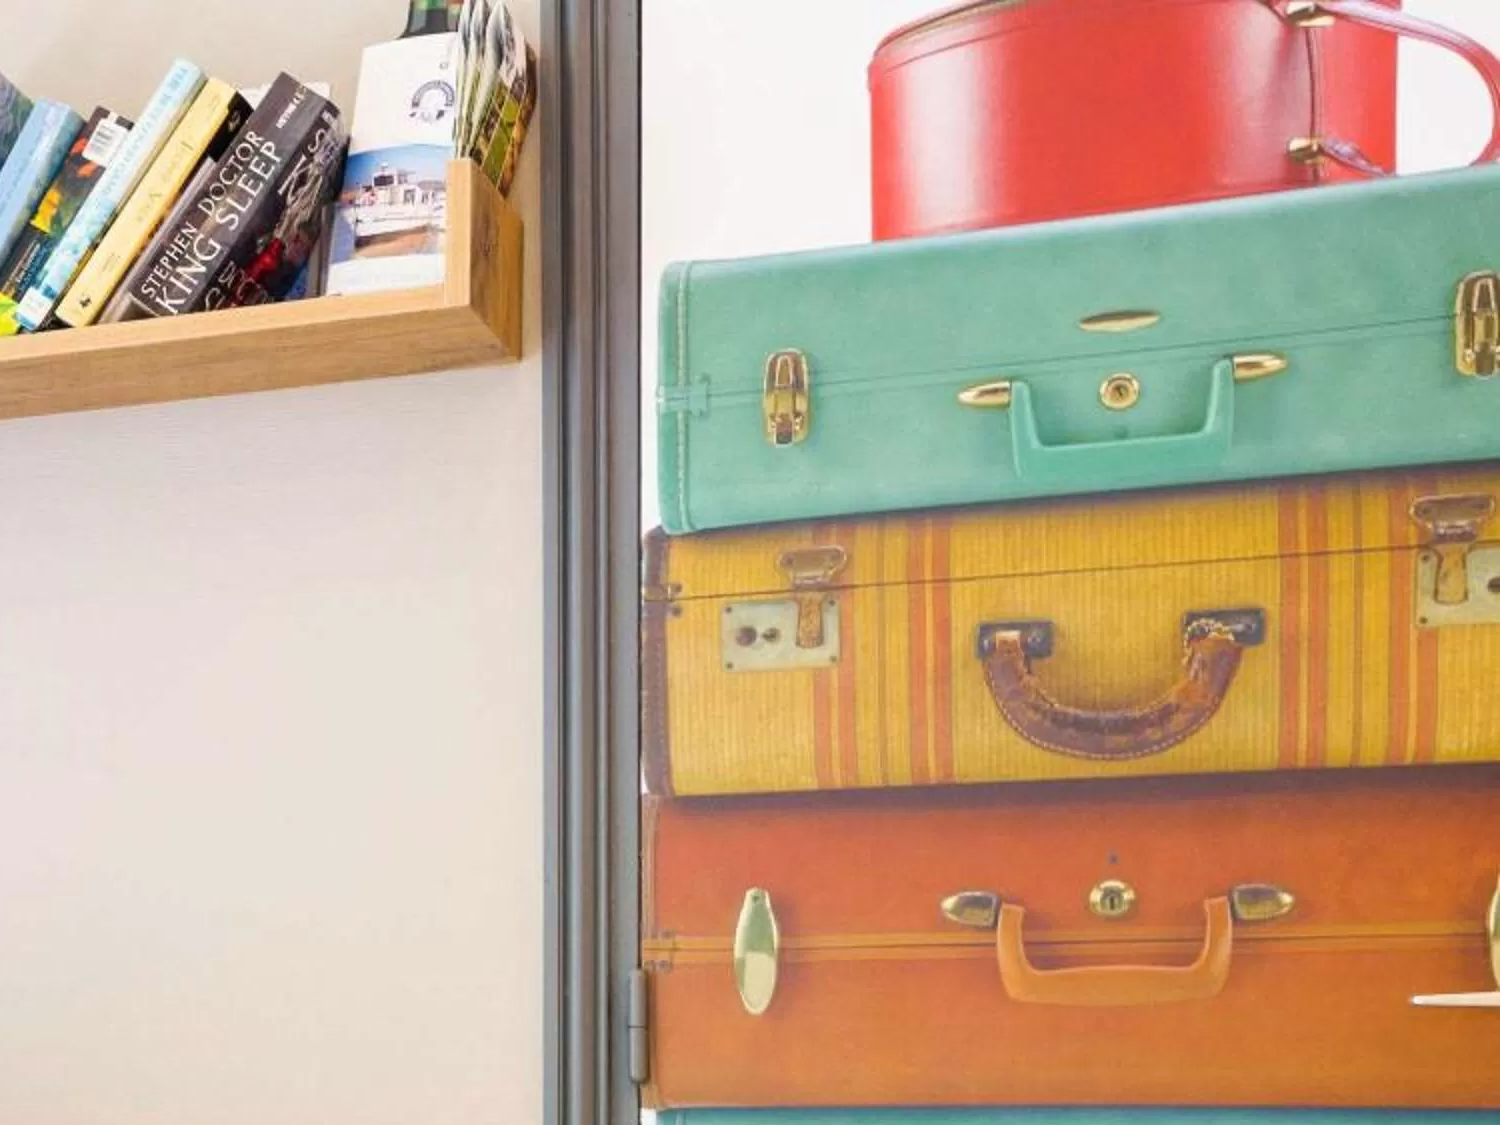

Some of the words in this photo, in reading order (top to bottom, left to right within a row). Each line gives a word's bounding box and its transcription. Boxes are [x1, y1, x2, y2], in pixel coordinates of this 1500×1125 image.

[198, 131, 265, 217] DOCTOR
[215, 140, 282, 231] SLEEP
[141, 221, 198, 299] STEPHEN
[155, 233, 221, 314] KING
